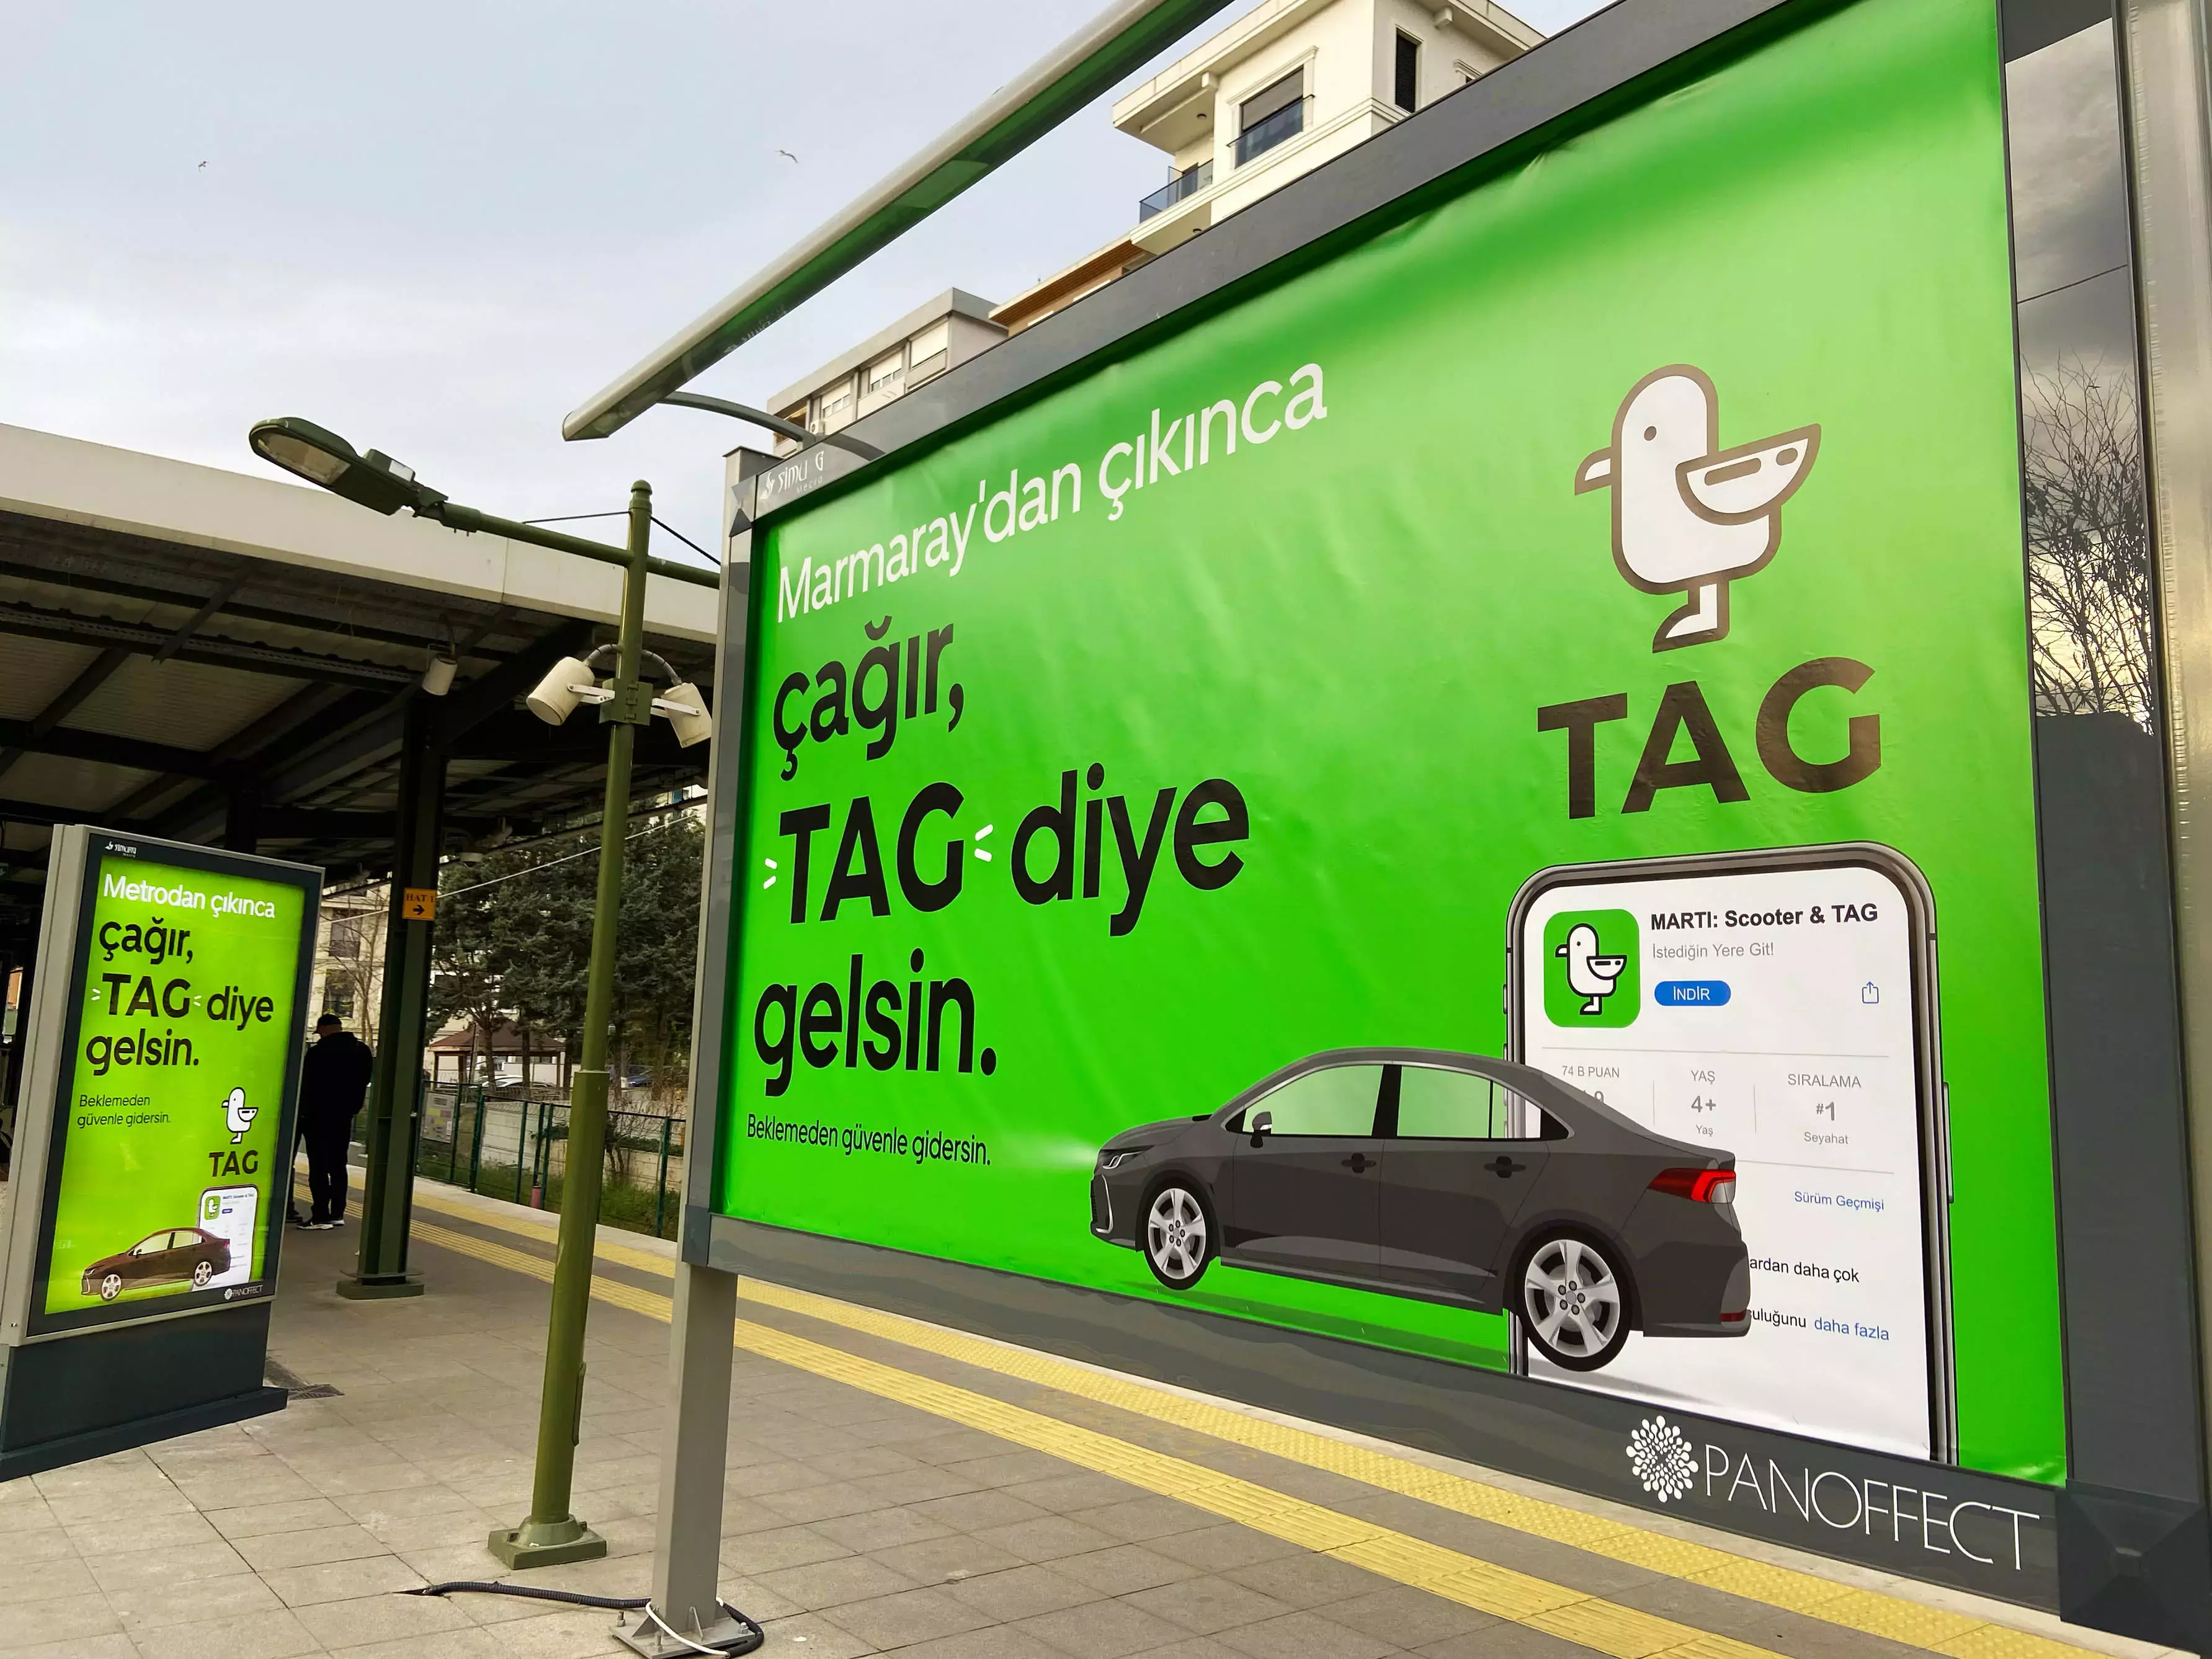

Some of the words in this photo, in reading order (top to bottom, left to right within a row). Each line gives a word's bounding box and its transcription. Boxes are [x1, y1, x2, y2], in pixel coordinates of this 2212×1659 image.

[777, 463, 1081, 623] Marmaray'dan
[1099, 363, 1327, 521] çıkınca
[774, 615, 965, 780] çağır,
[1538, 657, 1881, 819] TAG
[779, 781, 965, 925] TAG
[1010, 762, 1251, 937] diye
[104, 873, 206, 910] Metrodan
[210, 891, 275, 918] çıkınca
[406, 893, 428, 902] HAT
[1651, 911, 1718, 930] MARTI:
[1724, 909, 1803, 927] Scooter
[1809, 905, 1826, 924] &
[1831, 903, 1878, 923] TAG
[99, 916, 194, 964] çağır,
[1652, 943, 1708, 961] İstediğin
[1712, 943, 1744, 957] Yere
[1749, 941, 1774, 956] Git!
[102, 972, 191, 1018] TAG
[207, 985, 274, 1031] diye
[1672, 985, 1710, 1001] İNDİR
[754, 948, 997, 1097] gelsin.
[86, 1028, 199, 1076] gelsin.
[1562, 1065, 1574, 1076] 74
[1577, 1066, 1585, 1077] B
[1588, 1066, 1620, 1078] PUAN
[1691, 1070, 1716, 1085] YAŞ
[1787, 1074, 1862, 1088] SIRALAMA
[79, 1094, 150, 1107] Beklemeden
[1691, 1095, 1716, 1113] 4+
[1816, 1101, 1835, 1121] #1
[77, 1113, 123, 1129] güvenle
[125, 1112, 171, 1127] gidersin.
[1696, 1124, 1713, 1137] Yaş
[747, 1113, 838, 1147] Beklemeden
[841, 1129, 908, 1156] güvenle
[912, 1131, 991, 1166] gidersin.
[1804, 1132, 1849, 1145] Seyahat
[208, 1150, 259, 1177] TAG
[1794, 1191, 1832, 1205] Sürüm
[1836, 1195, 1884, 1212] Geçmişi
[1749, 1257, 1789, 1273] ardan
[1794, 1262, 1829, 1279] daha
[1833, 1268, 1860, 1283] çok
[1814, 1317, 1850, 1335] daha
[1854, 1322, 1889, 1341] fazla
[1706, 1444, 2040, 1571] PANOFFECT
